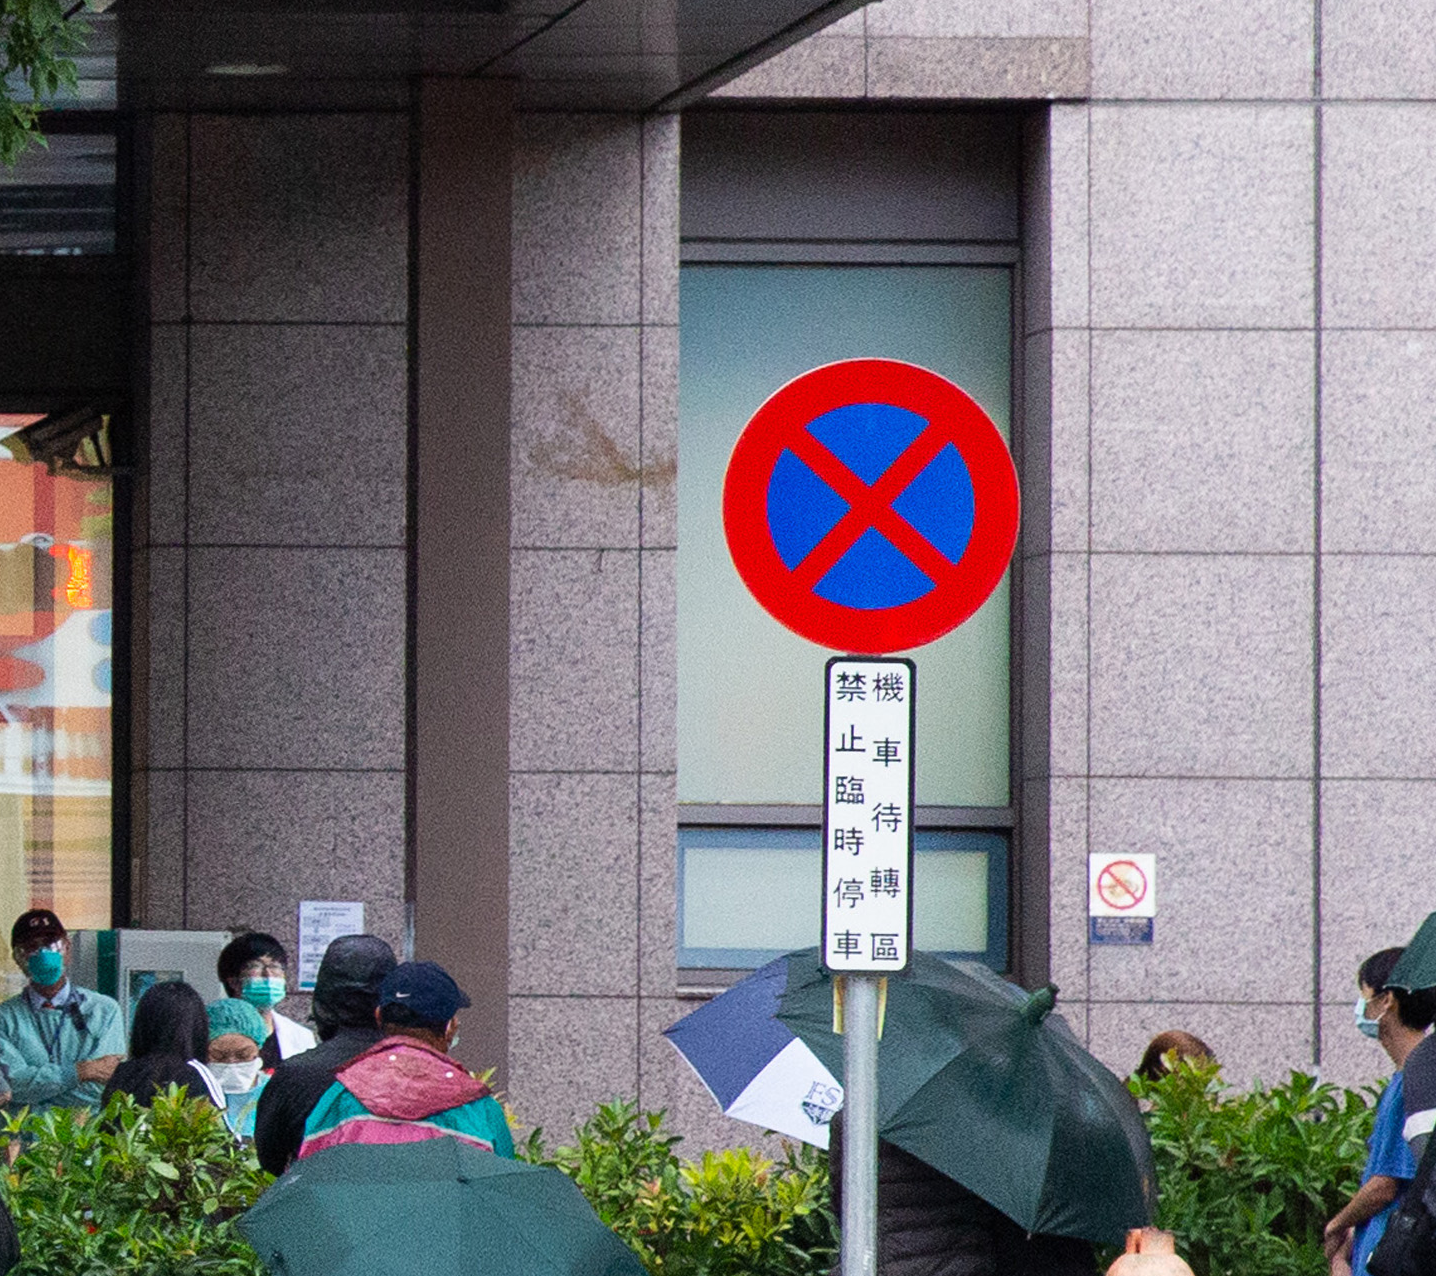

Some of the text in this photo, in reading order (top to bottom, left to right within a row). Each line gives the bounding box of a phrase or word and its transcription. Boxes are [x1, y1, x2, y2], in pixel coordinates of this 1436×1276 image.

[833, 671, 867, 961] 禁止臨時停車
[870, 671, 904, 961] 機車待轉區
